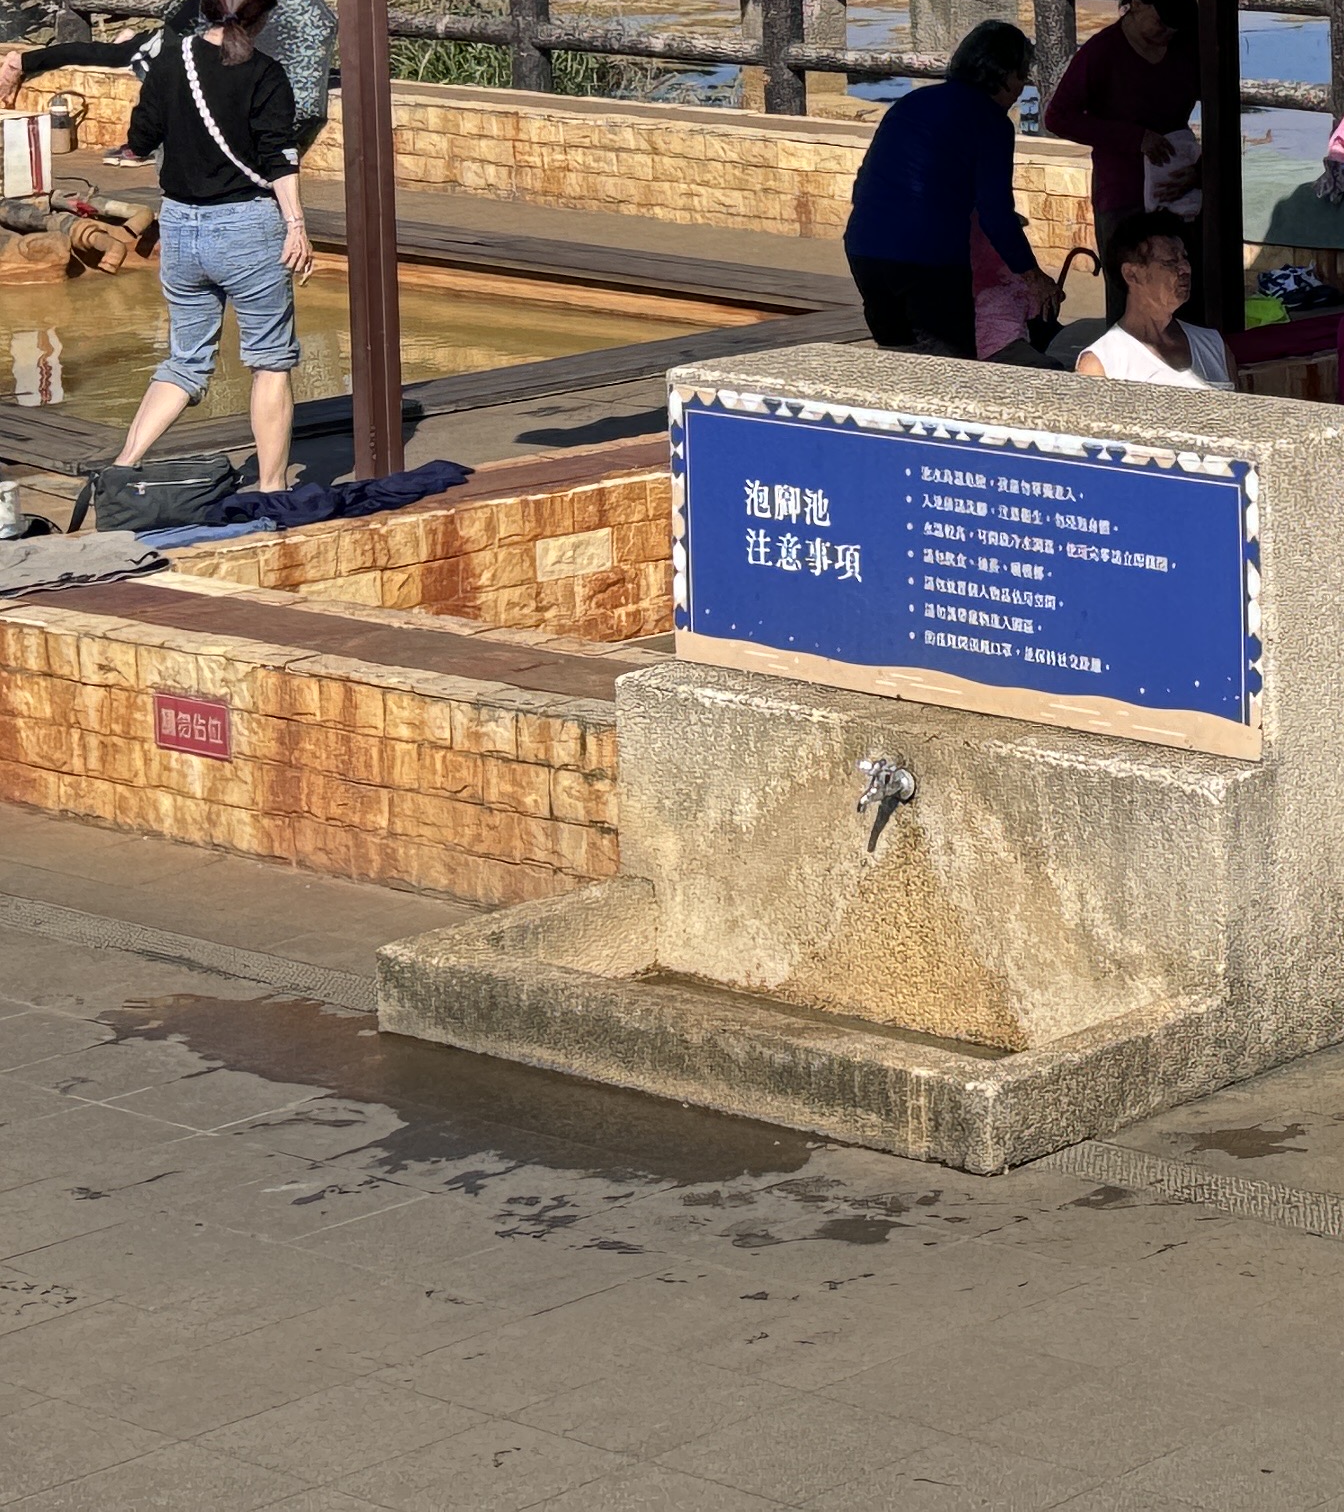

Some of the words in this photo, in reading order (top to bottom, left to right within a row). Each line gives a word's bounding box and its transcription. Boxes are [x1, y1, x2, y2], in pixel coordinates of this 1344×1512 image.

[744, 479, 831, 529] 泡腳池
[745, 529, 862, 583] 注意事項
